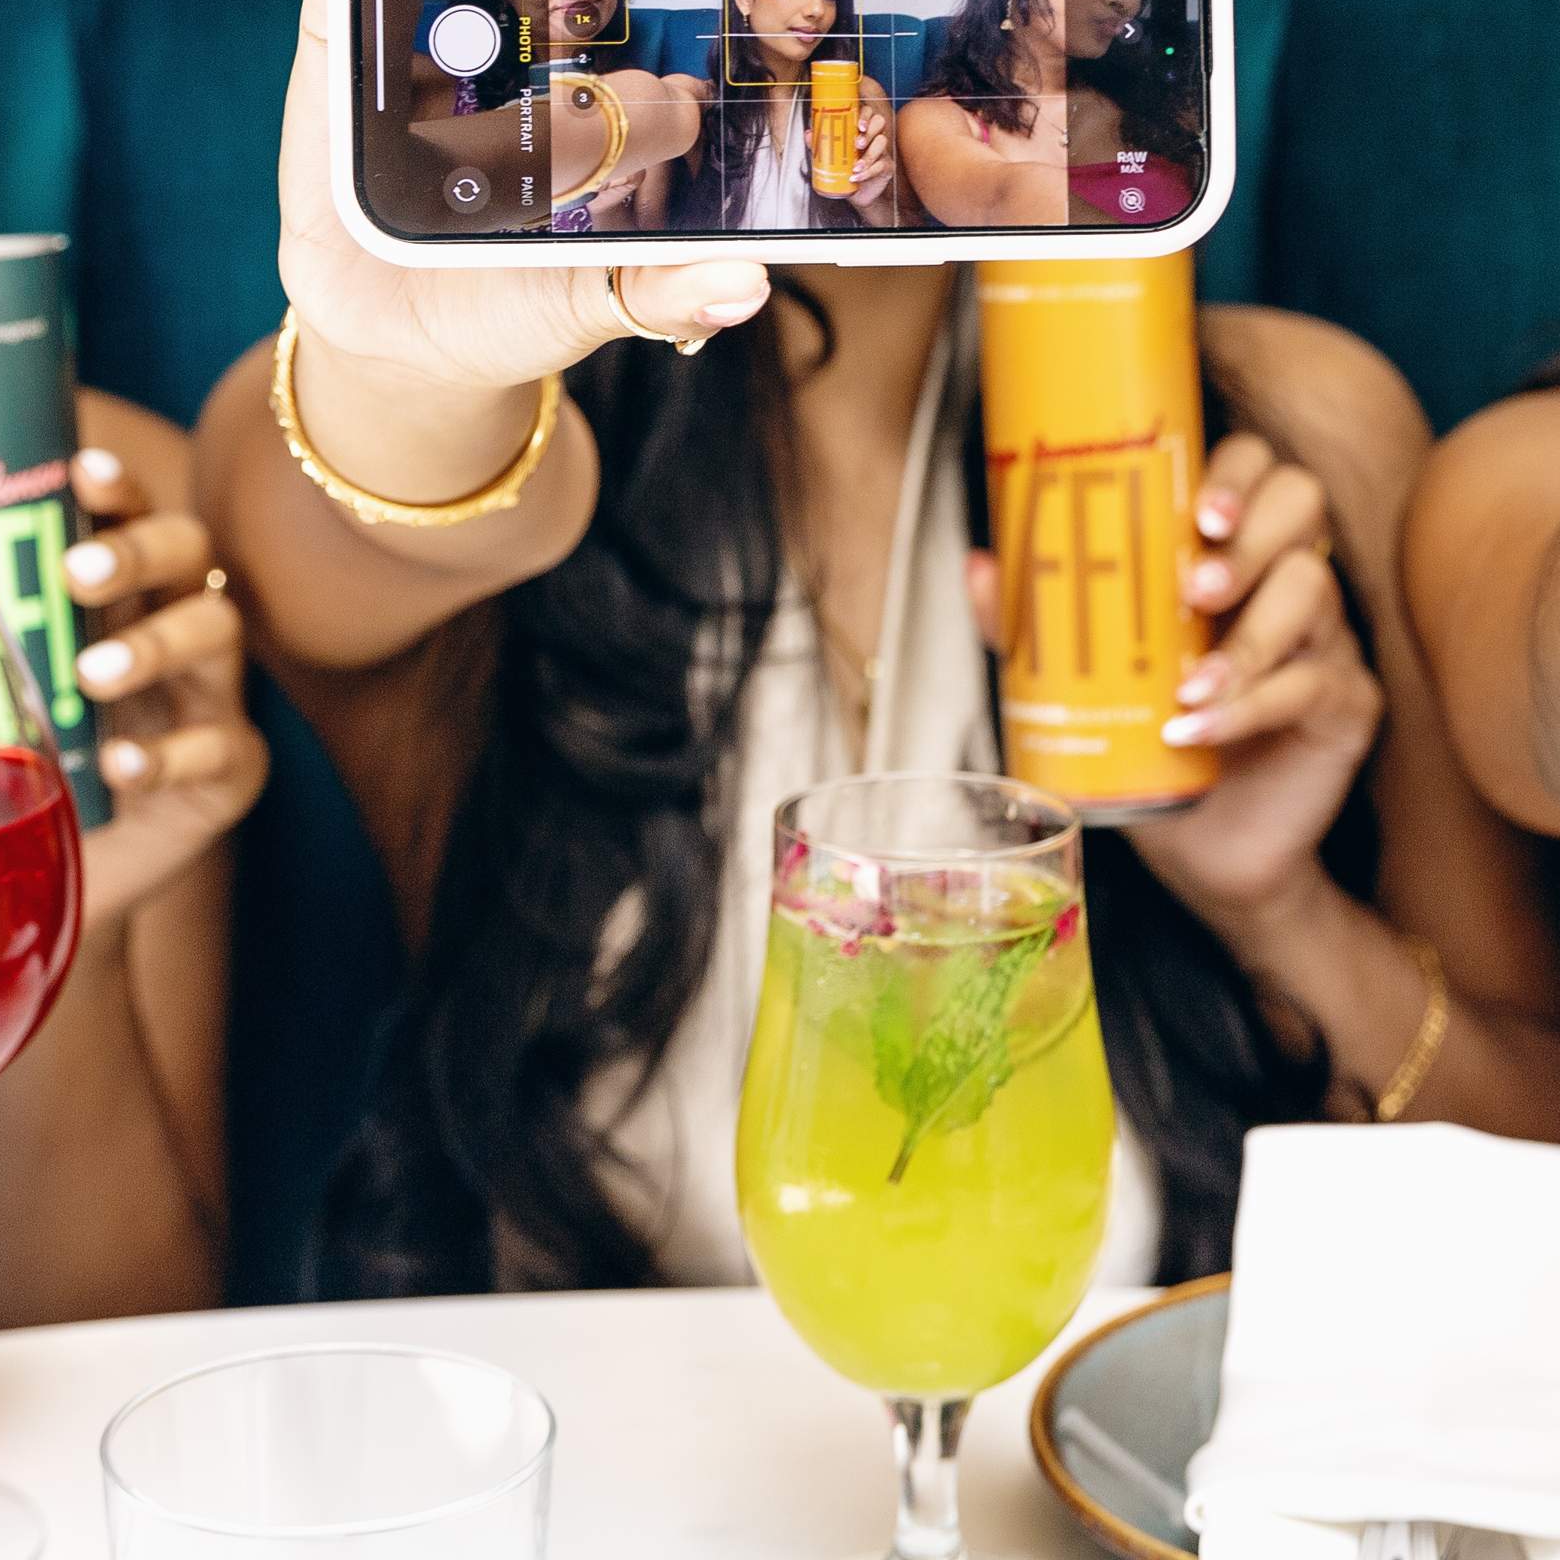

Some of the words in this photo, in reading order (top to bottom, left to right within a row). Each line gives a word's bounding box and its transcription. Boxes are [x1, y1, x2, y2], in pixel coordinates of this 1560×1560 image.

[519, 17, 531, 63] PHOTO
[579, 54, 587, 64] 2
[580, 93, 588, 102] 3
[520, 89, 532, 153] PORTRAIT
[1117, 151, 1148, 163] RAW
[1120, 163, 1145, 173] MAX
[521, 176, 533, 206] PANO
